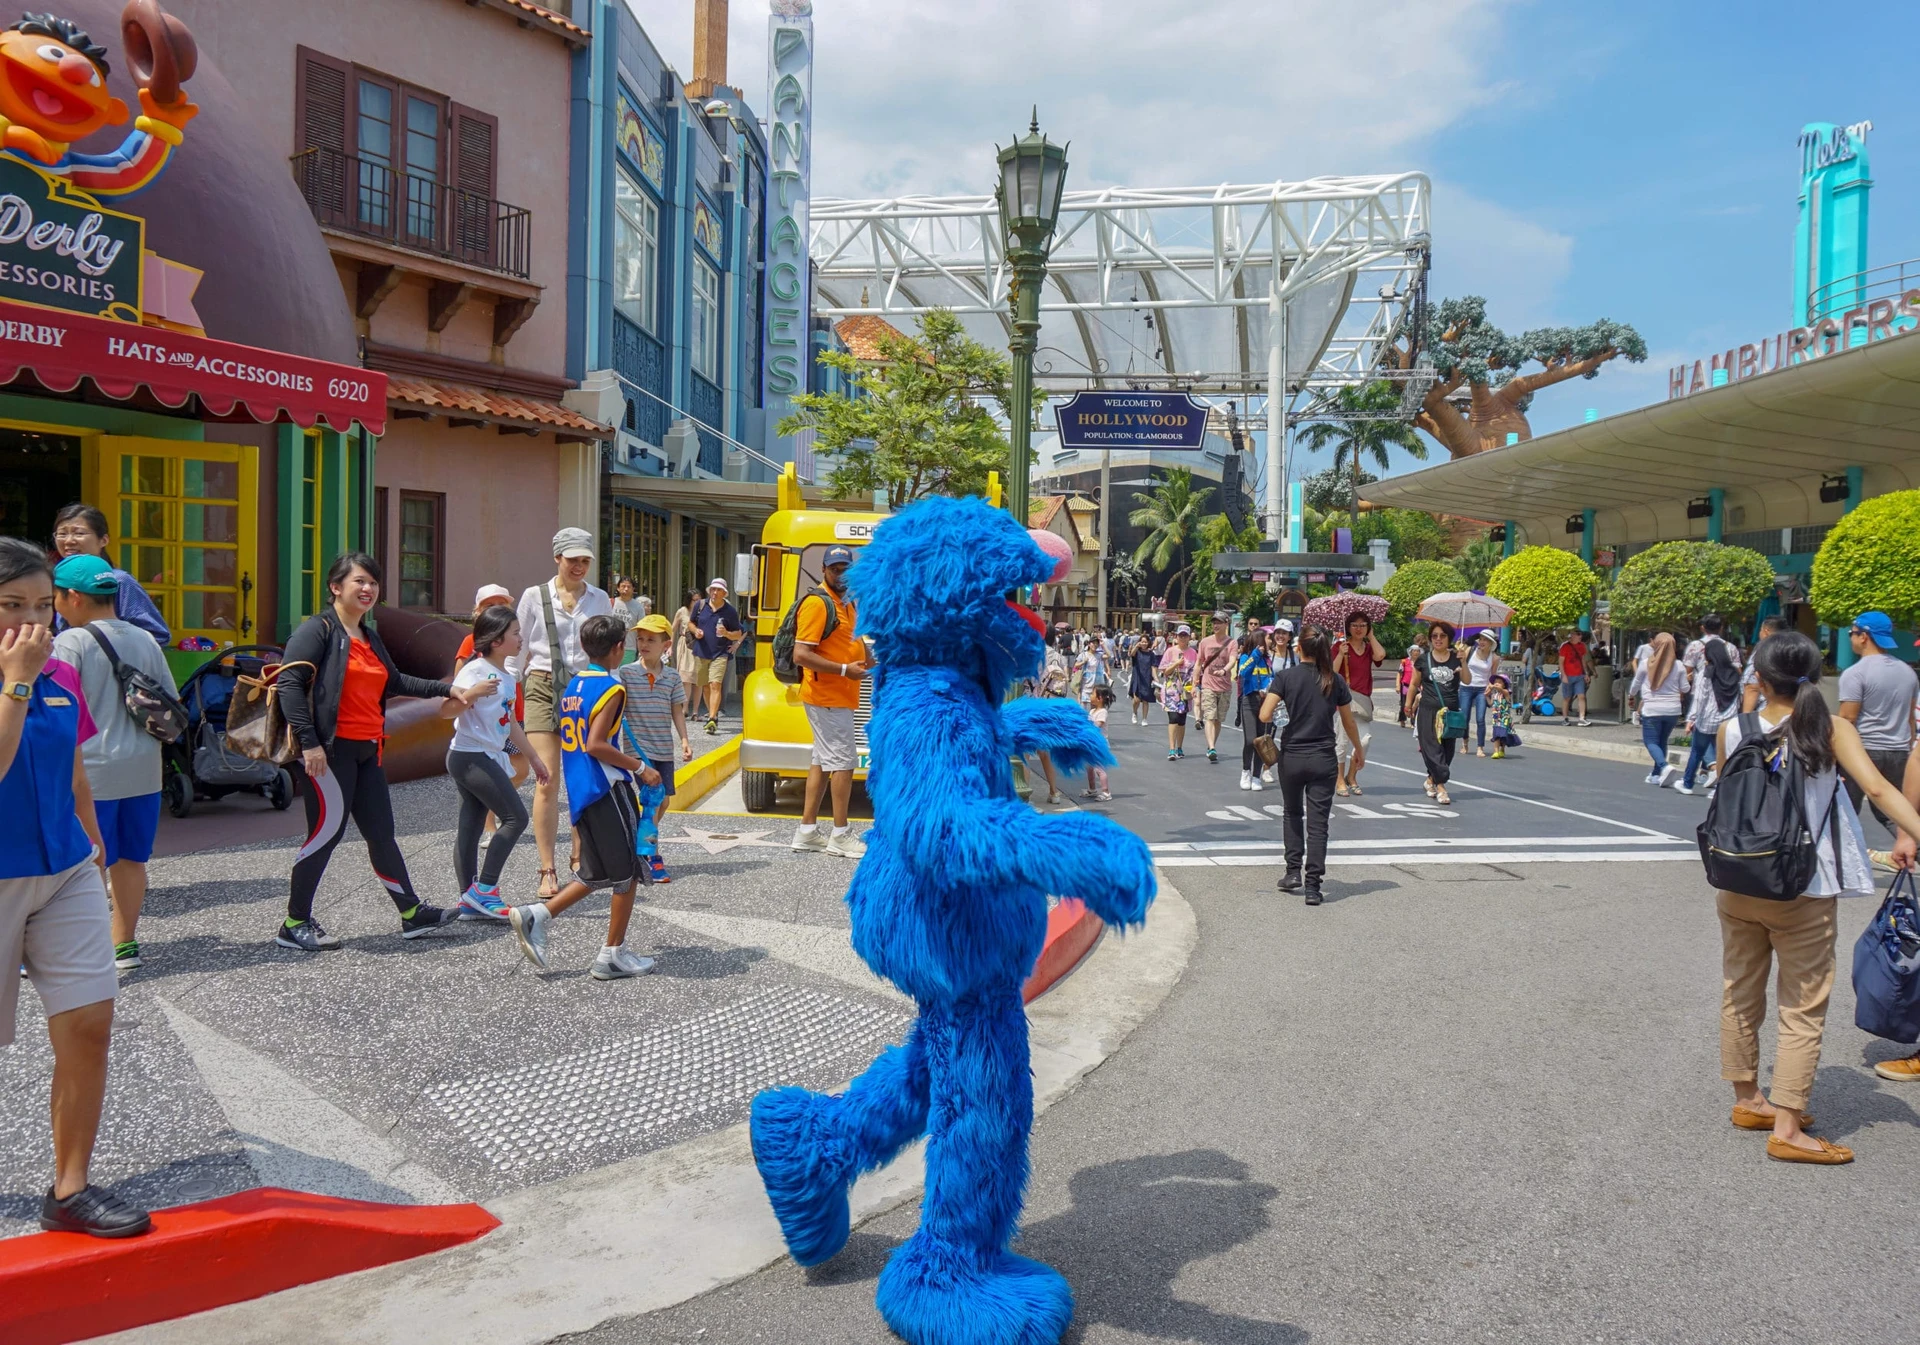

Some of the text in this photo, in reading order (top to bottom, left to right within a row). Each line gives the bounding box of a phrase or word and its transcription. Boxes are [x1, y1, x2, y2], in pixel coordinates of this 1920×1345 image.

[768, 28, 804, 393] PANTAGES
[0, 193, 124, 276] Derby
[108, 337, 369, 402] HATS AND ACCESSORIES 6920
[1078, 413, 1188, 427] HOLLYWOOD
[1104, 399, 1162, 408] WELCOME TO
[1084, 432, 1183, 440] POPULATION: GLAMOROUS
